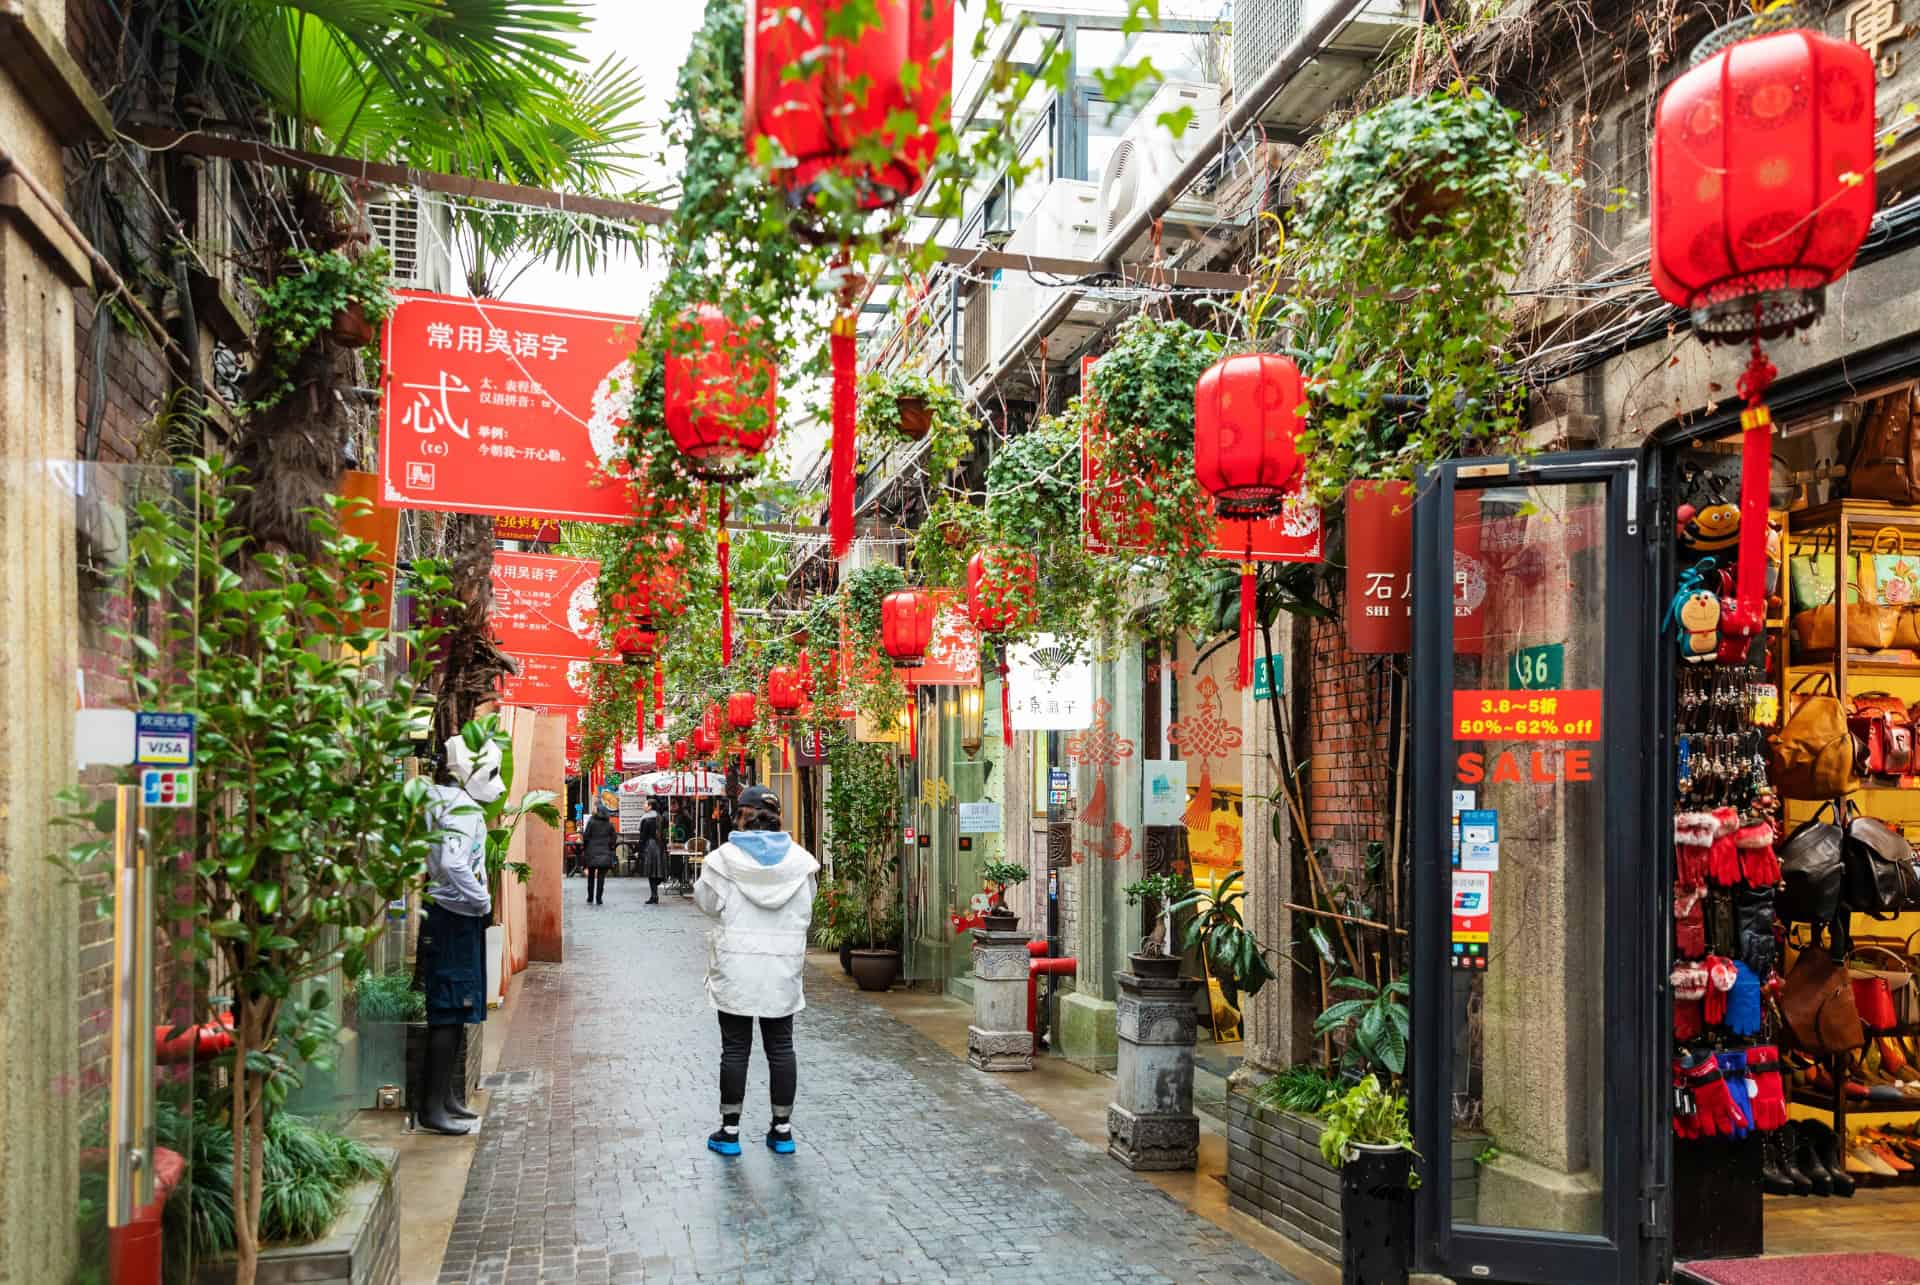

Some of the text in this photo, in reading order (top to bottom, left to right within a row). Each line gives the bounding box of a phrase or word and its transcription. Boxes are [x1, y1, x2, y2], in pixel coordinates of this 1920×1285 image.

[427, 322, 568, 360] 常用吴语字
[1365, 606, 1390, 617] SHI
[1522, 653, 1548, 684] 36
[1564, 719, 1593, 735] off
[148, 741, 183, 753] VISA
[1456, 749, 1593, 784] SALE
[144, 772, 190, 804] JCB
